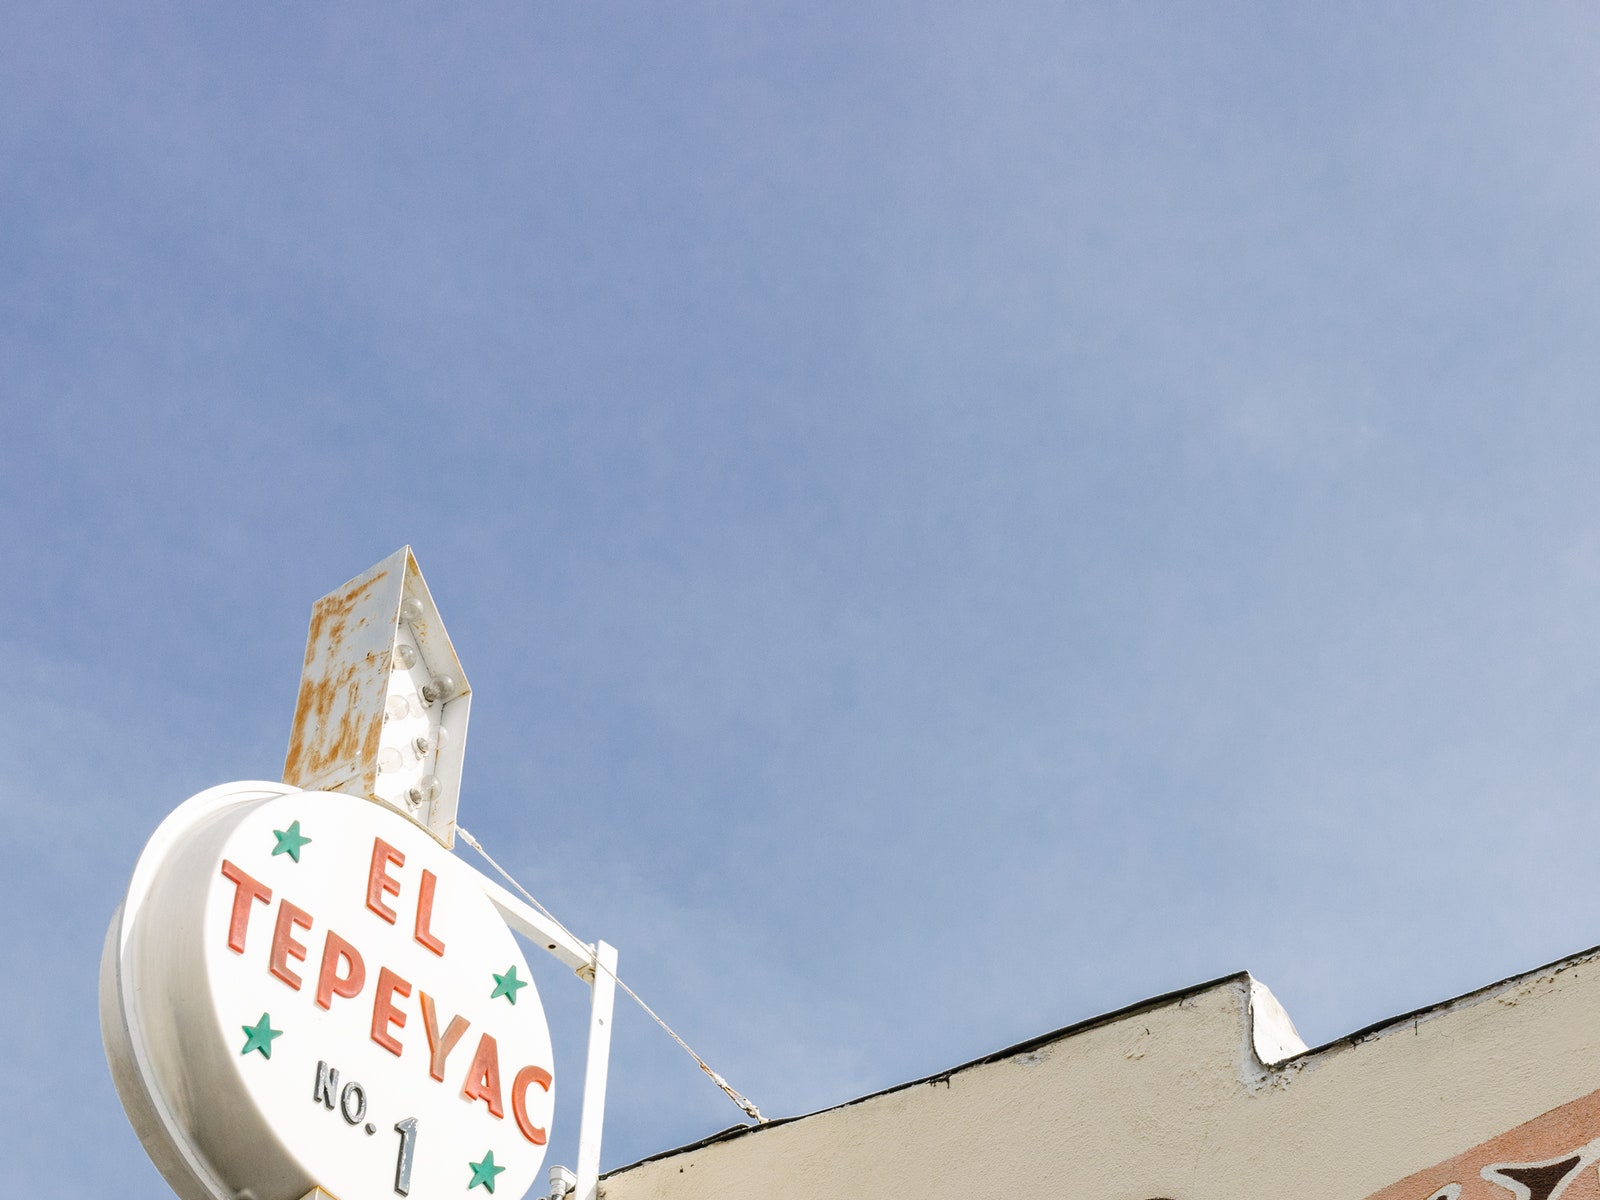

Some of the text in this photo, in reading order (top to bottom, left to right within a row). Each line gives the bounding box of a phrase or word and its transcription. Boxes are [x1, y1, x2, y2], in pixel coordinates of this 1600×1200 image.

[367, 837, 445, 957] EL
[221, 859, 552, 1145] TEPEYAC
[313, 1060, 418, 1198] NO. 1
